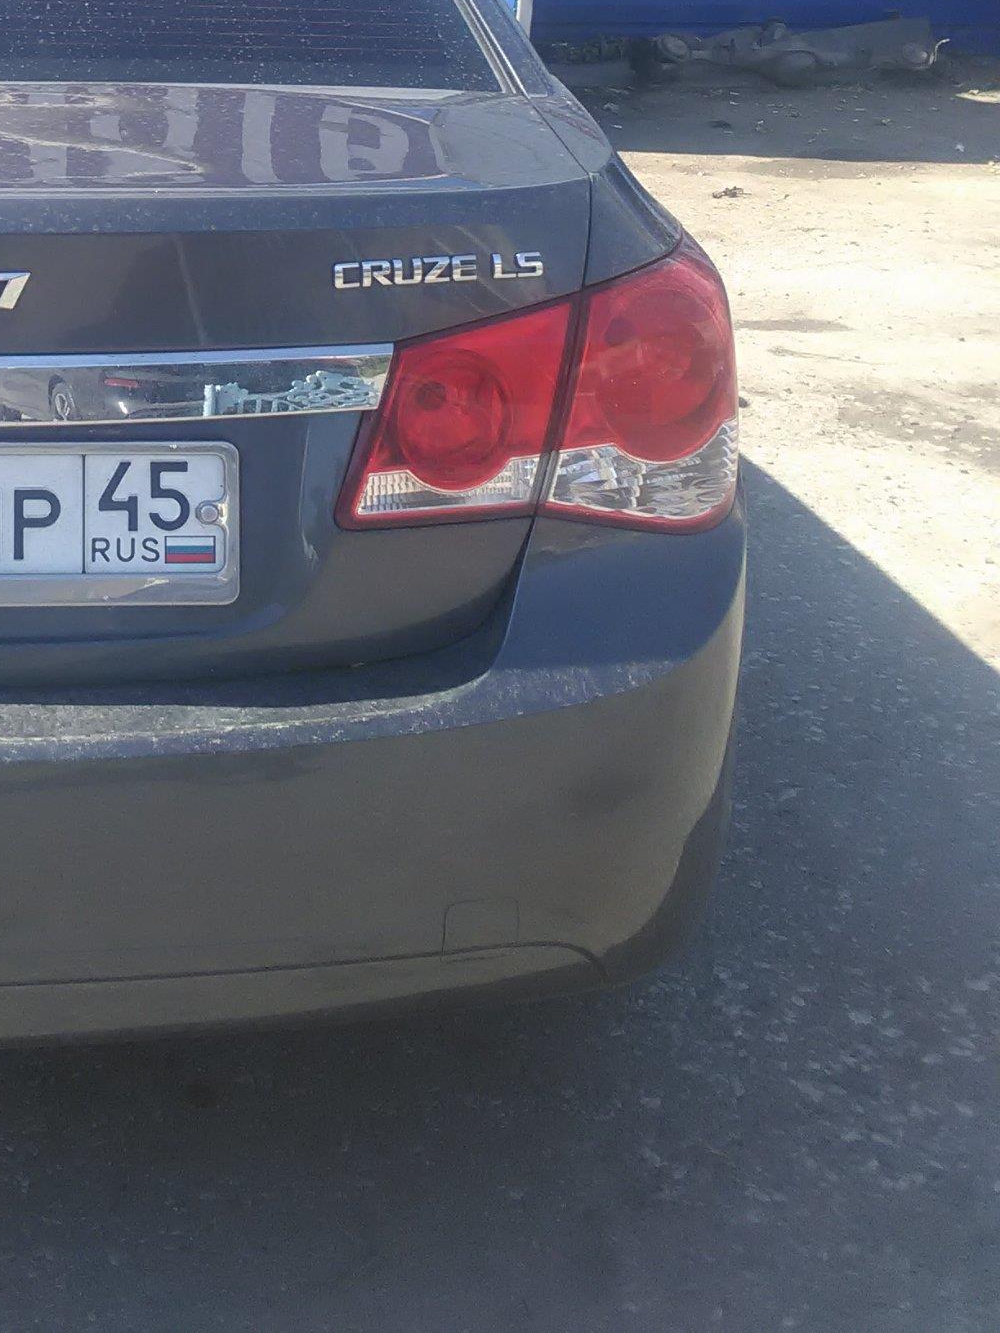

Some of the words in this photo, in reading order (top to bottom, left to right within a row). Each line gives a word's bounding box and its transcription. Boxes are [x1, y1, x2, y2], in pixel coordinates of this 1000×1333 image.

[333, 254, 478, 289] CRUZE
[493, 251, 544, 279] LS
[98, 460, 191, 533] 45
[90, 537, 161, 563] RUS
